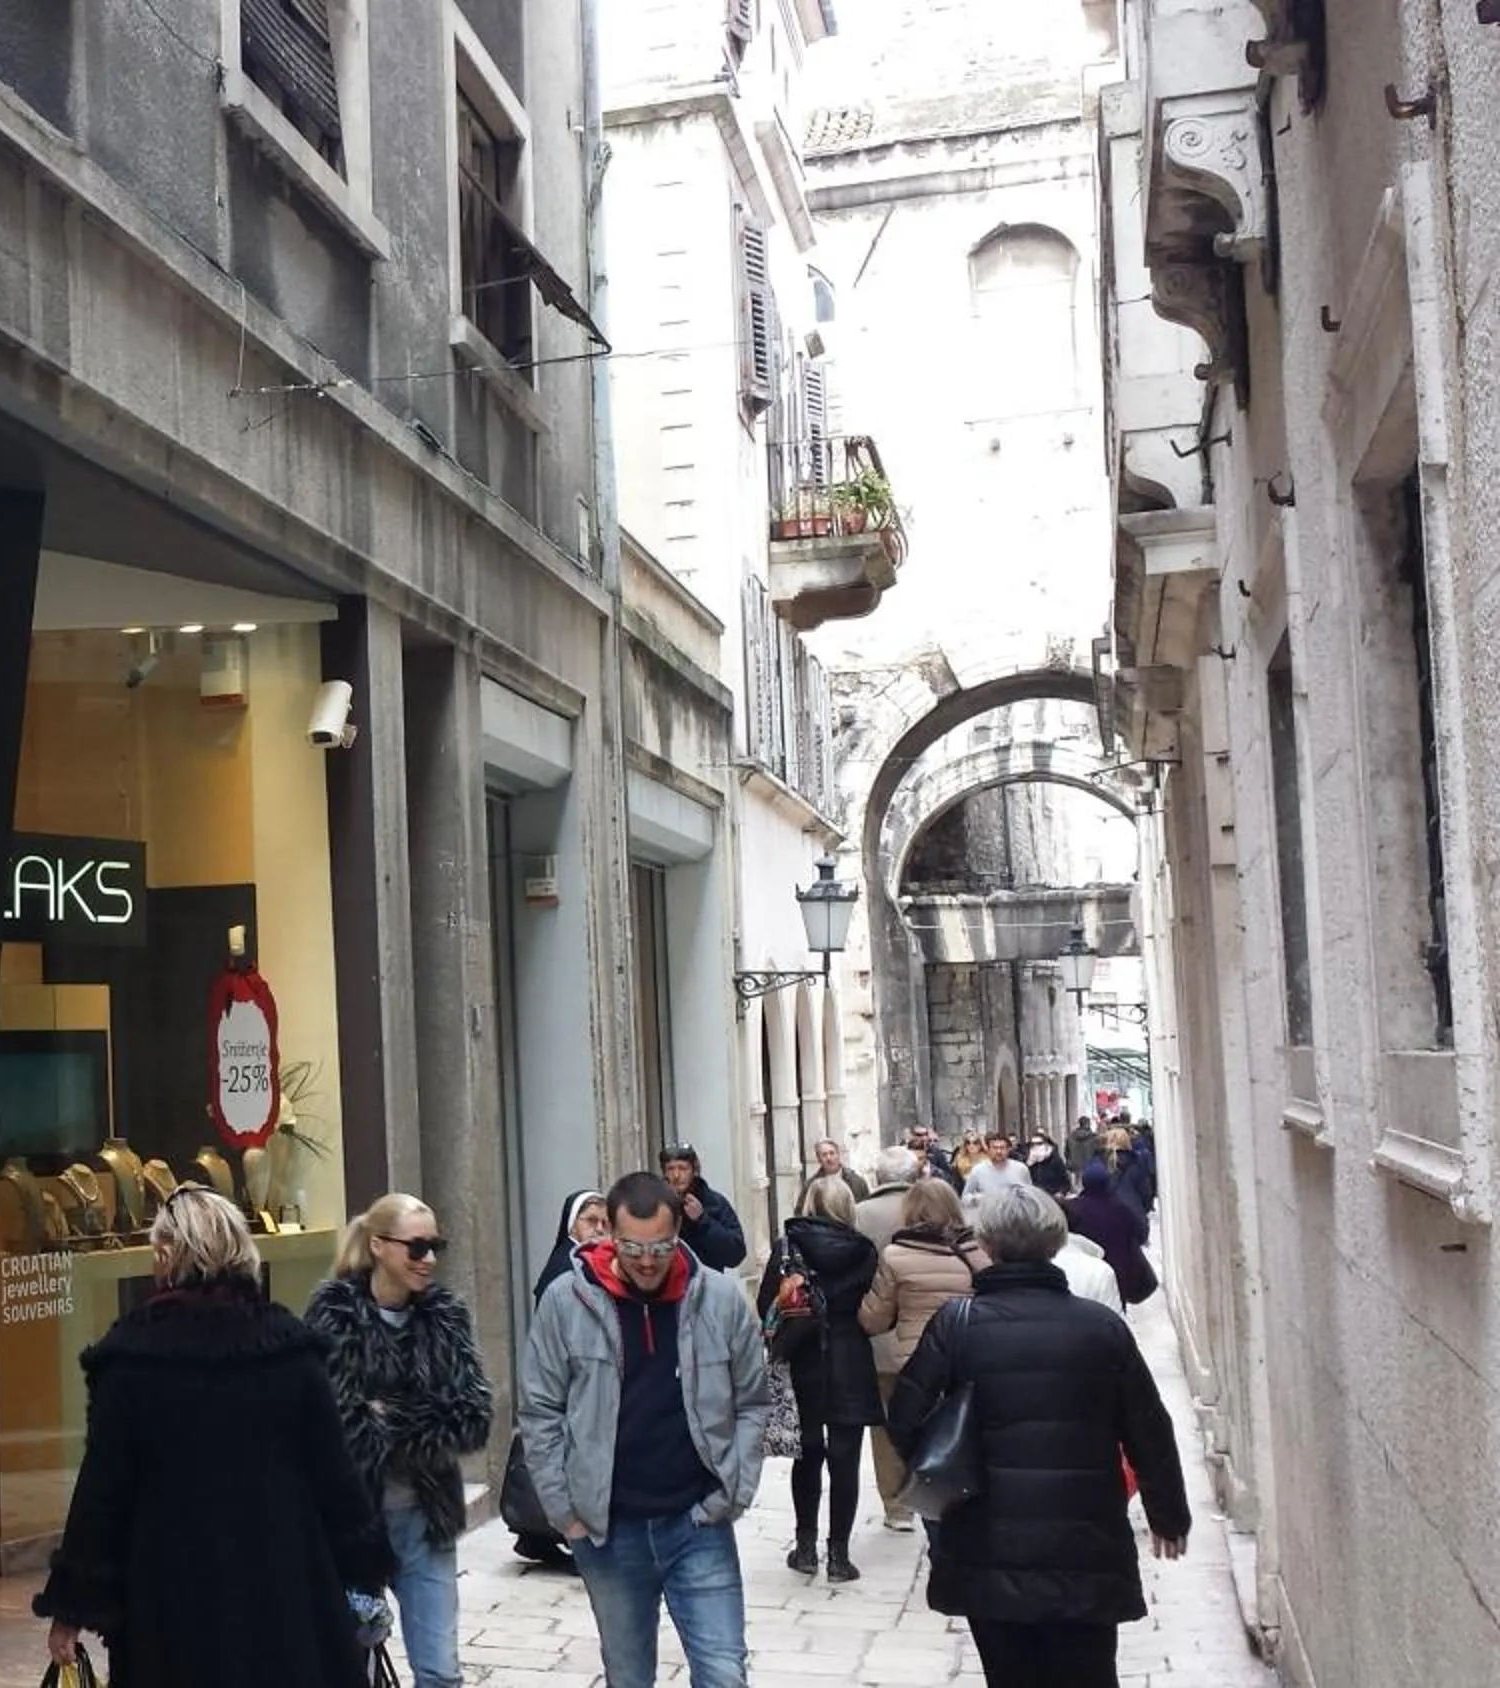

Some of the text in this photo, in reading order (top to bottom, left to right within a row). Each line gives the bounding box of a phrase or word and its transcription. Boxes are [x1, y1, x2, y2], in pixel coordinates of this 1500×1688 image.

[221, 1064, 269, 1093] -25%
[1, 1250, 73, 1278] CROATIAN
[1, 1272, 72, 1306] jewellery
[3, 1296, 74, 1325] SOUVENIRS
